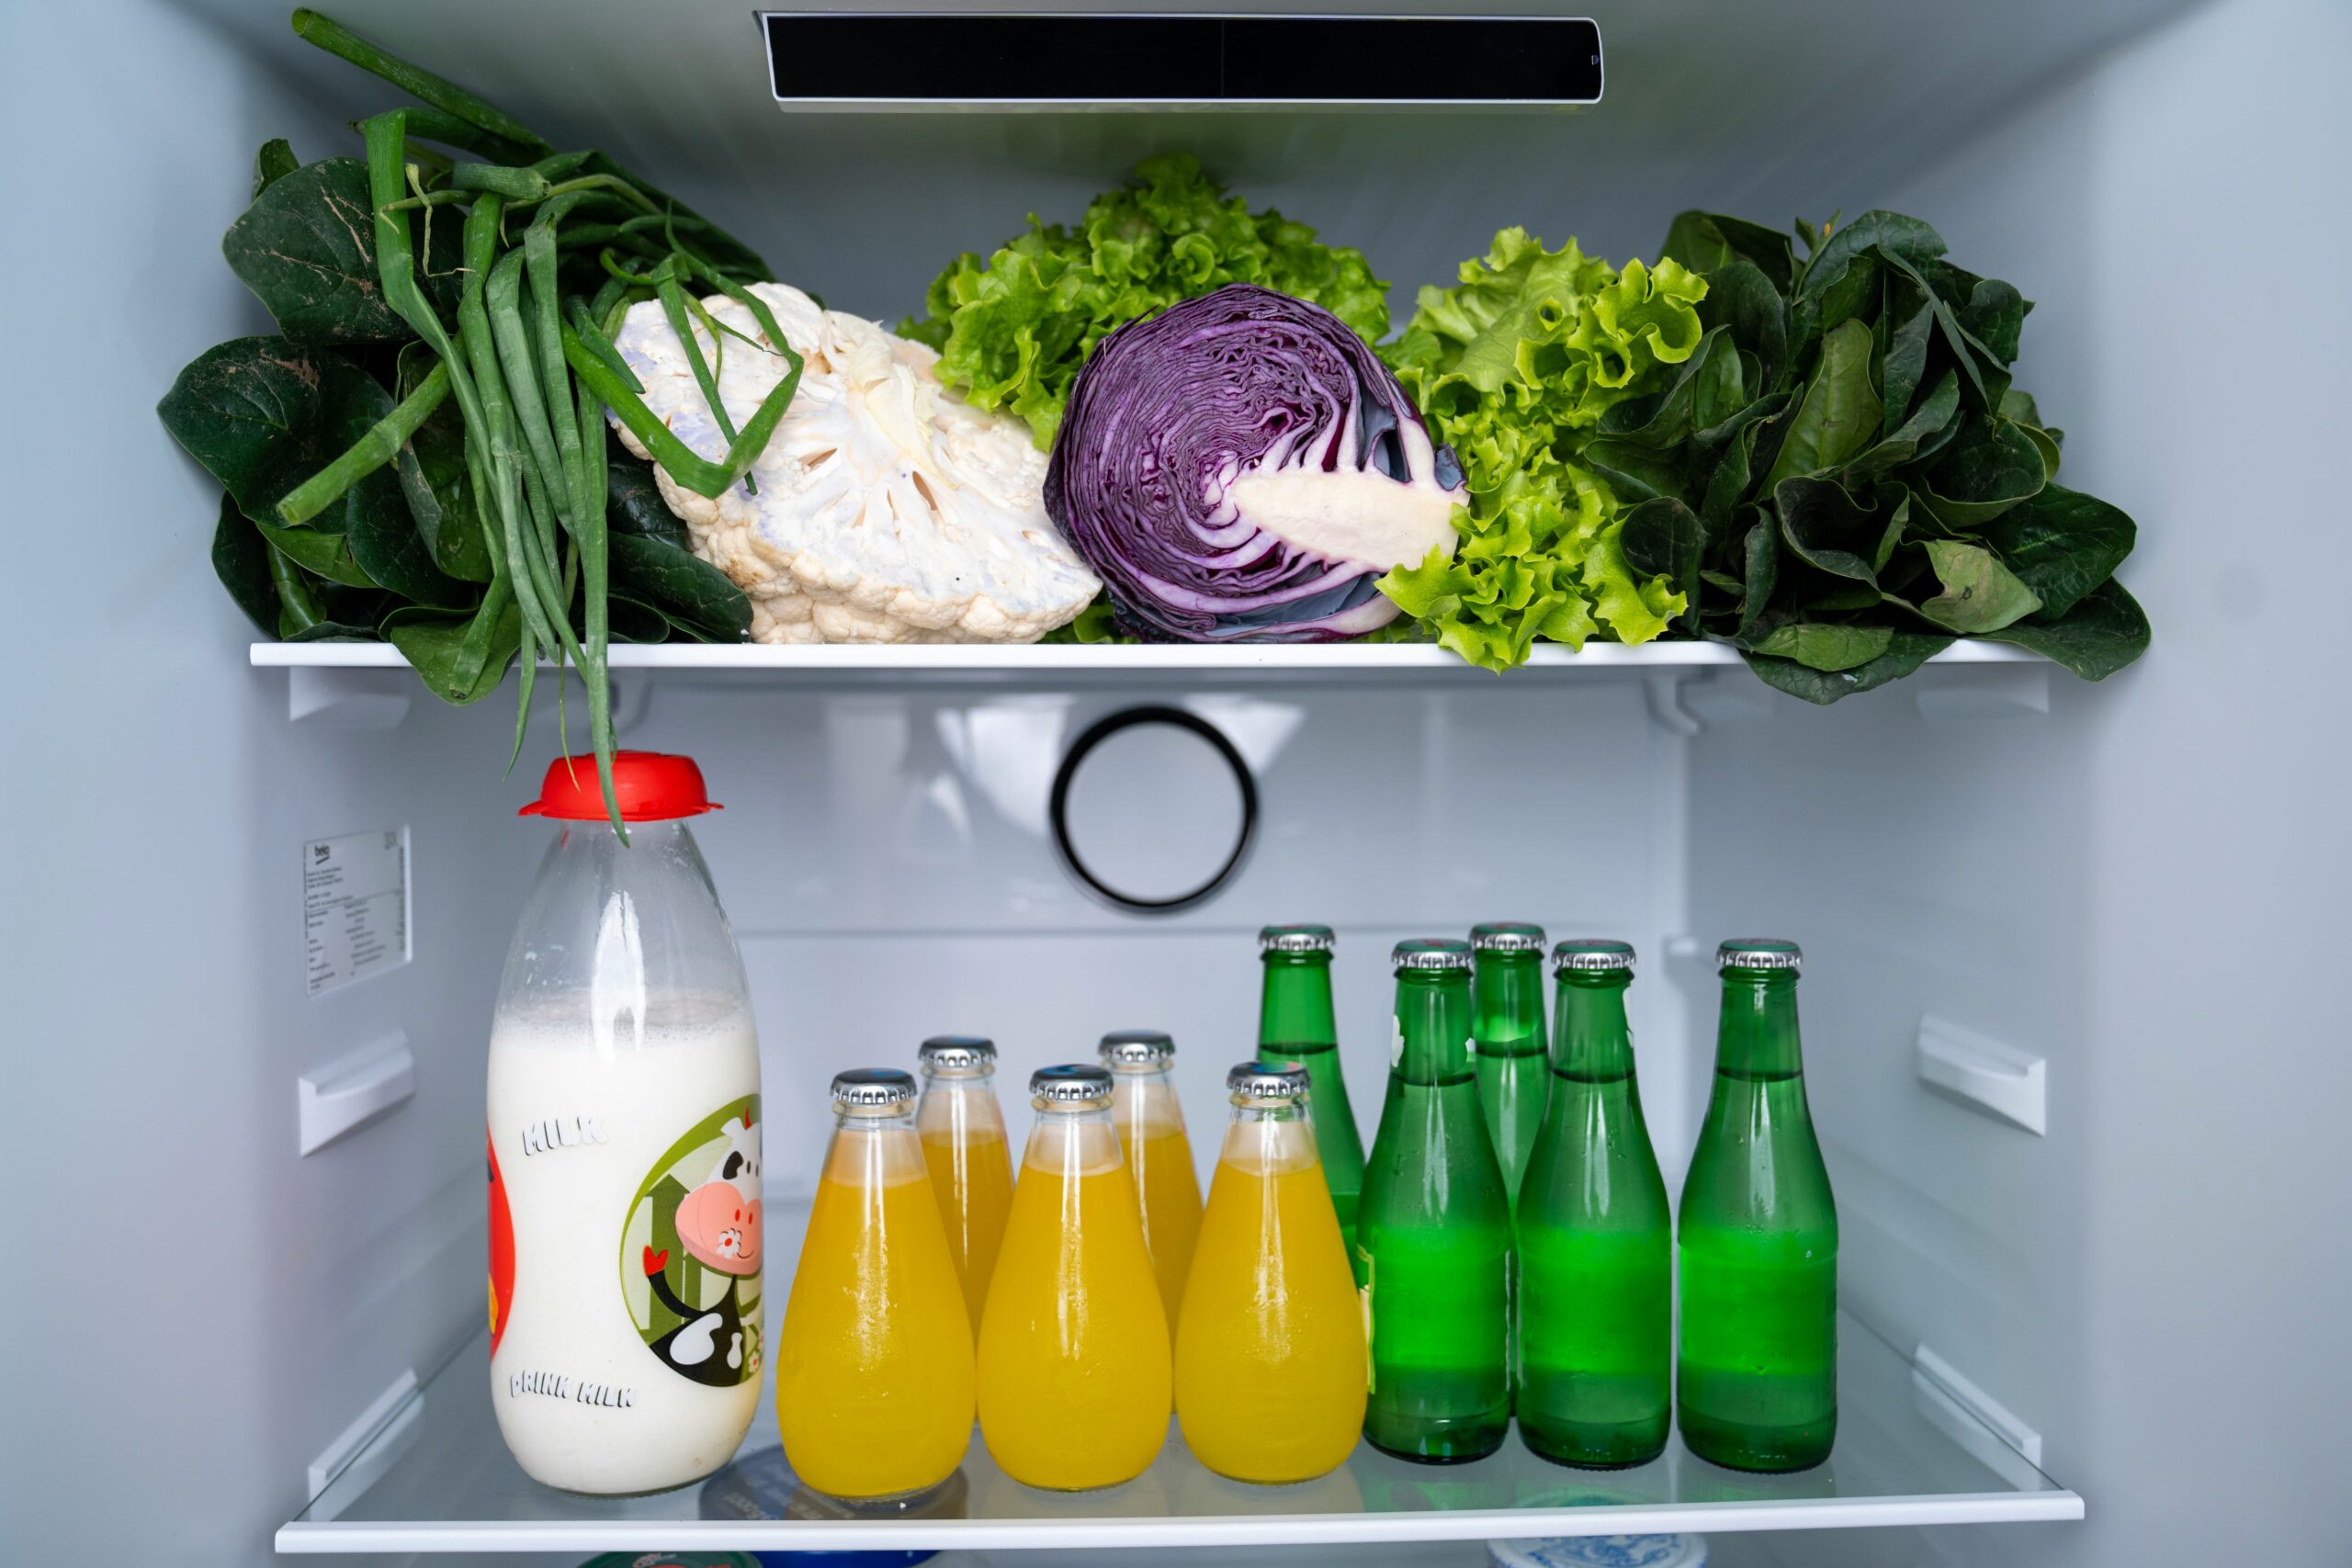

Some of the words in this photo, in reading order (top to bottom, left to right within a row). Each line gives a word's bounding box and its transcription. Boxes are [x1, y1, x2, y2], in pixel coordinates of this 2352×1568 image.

[522, 1115, 608, 1156] MILK
[510, 1370, 572, 1399] DRINK
[576, 1382, 636, 1408] MILK
